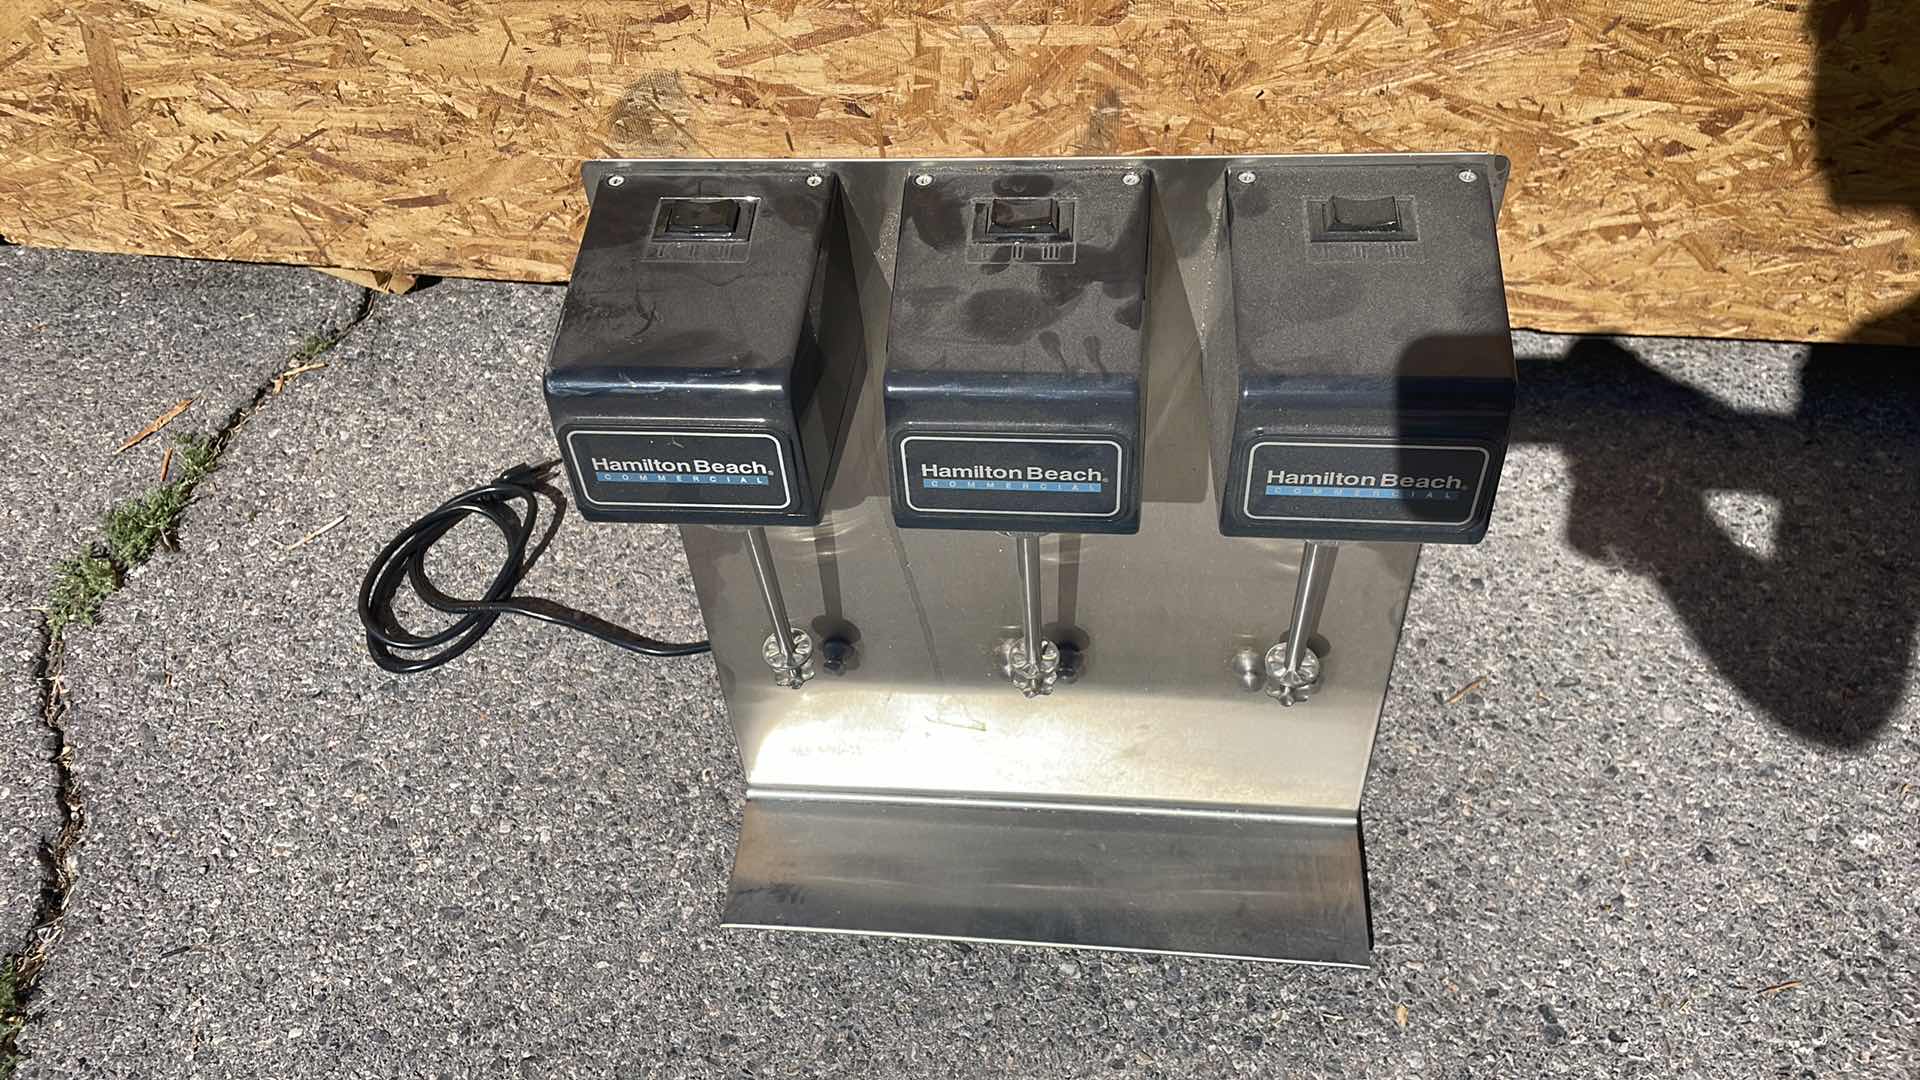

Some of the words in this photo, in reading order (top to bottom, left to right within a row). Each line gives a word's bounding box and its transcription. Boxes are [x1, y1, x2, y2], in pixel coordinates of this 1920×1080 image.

[591, 457, 691, 473] Hamilton
[921, 463, 1023, 480] Hamilton
[604, 474, 764, 484] COMMERCIAL
[931, 480, 1096, 491] COMMERCIAL
[1266, 470, 1376, 487] Hamilton
[1274, 486, 1453, 498] COMMERCIAL
